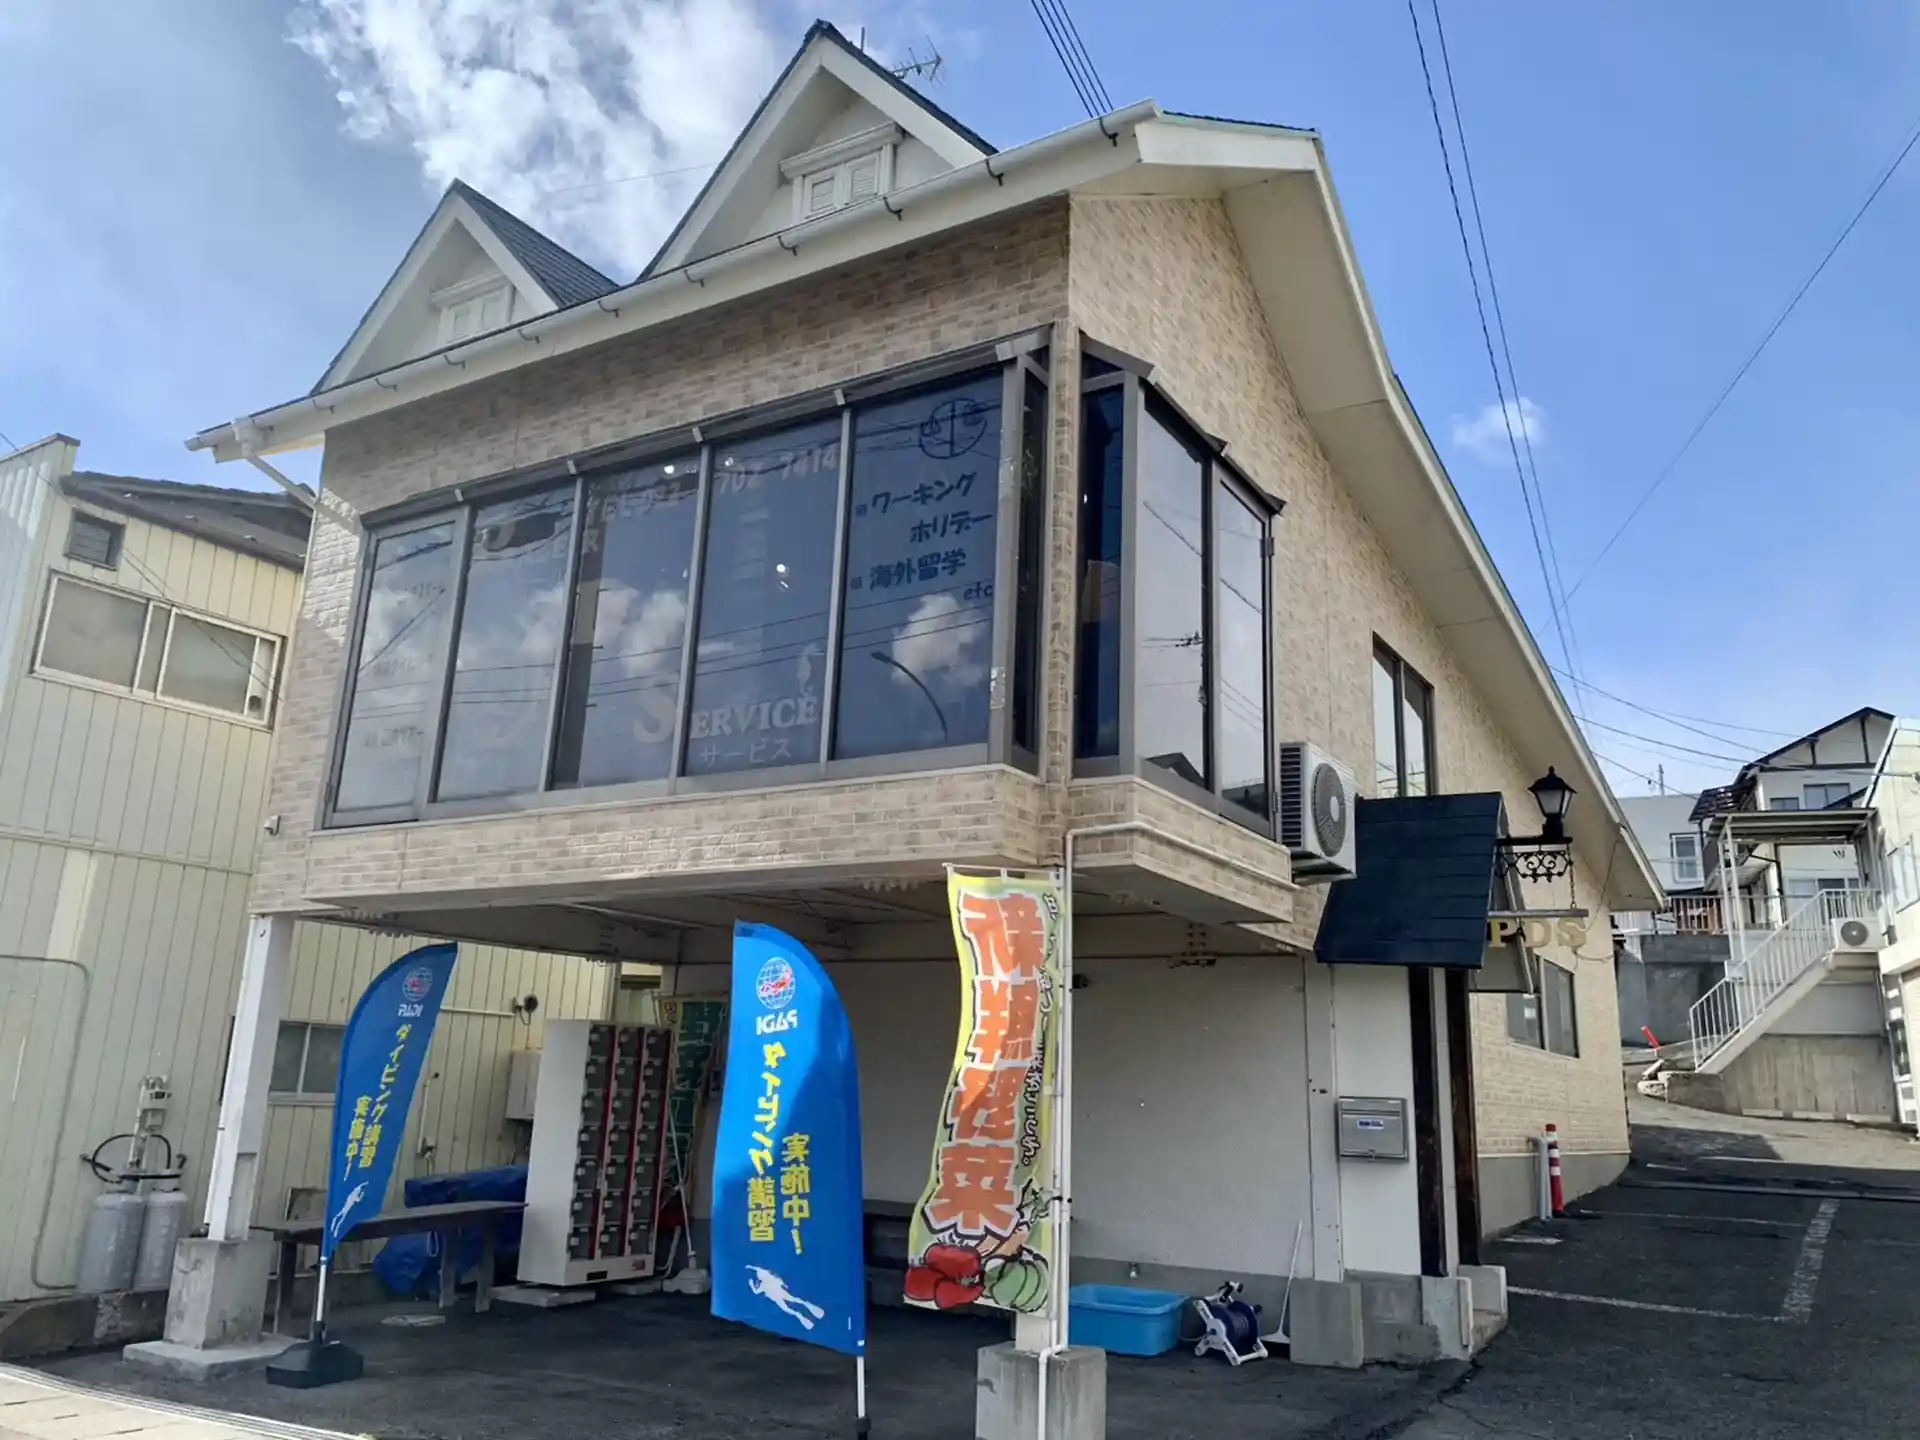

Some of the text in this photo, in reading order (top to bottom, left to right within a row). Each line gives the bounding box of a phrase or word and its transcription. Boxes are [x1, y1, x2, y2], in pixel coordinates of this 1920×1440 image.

[871, 471, 978, 514] ワーキング
[909, 509, 994, 543] ホリデー
[869, 547, 967, 592] 海外留学
[632, 674, 818, 745] SERVICE
[699, 735, 792, 769] サービス
[1488, 916, 1588, 948] PDS
